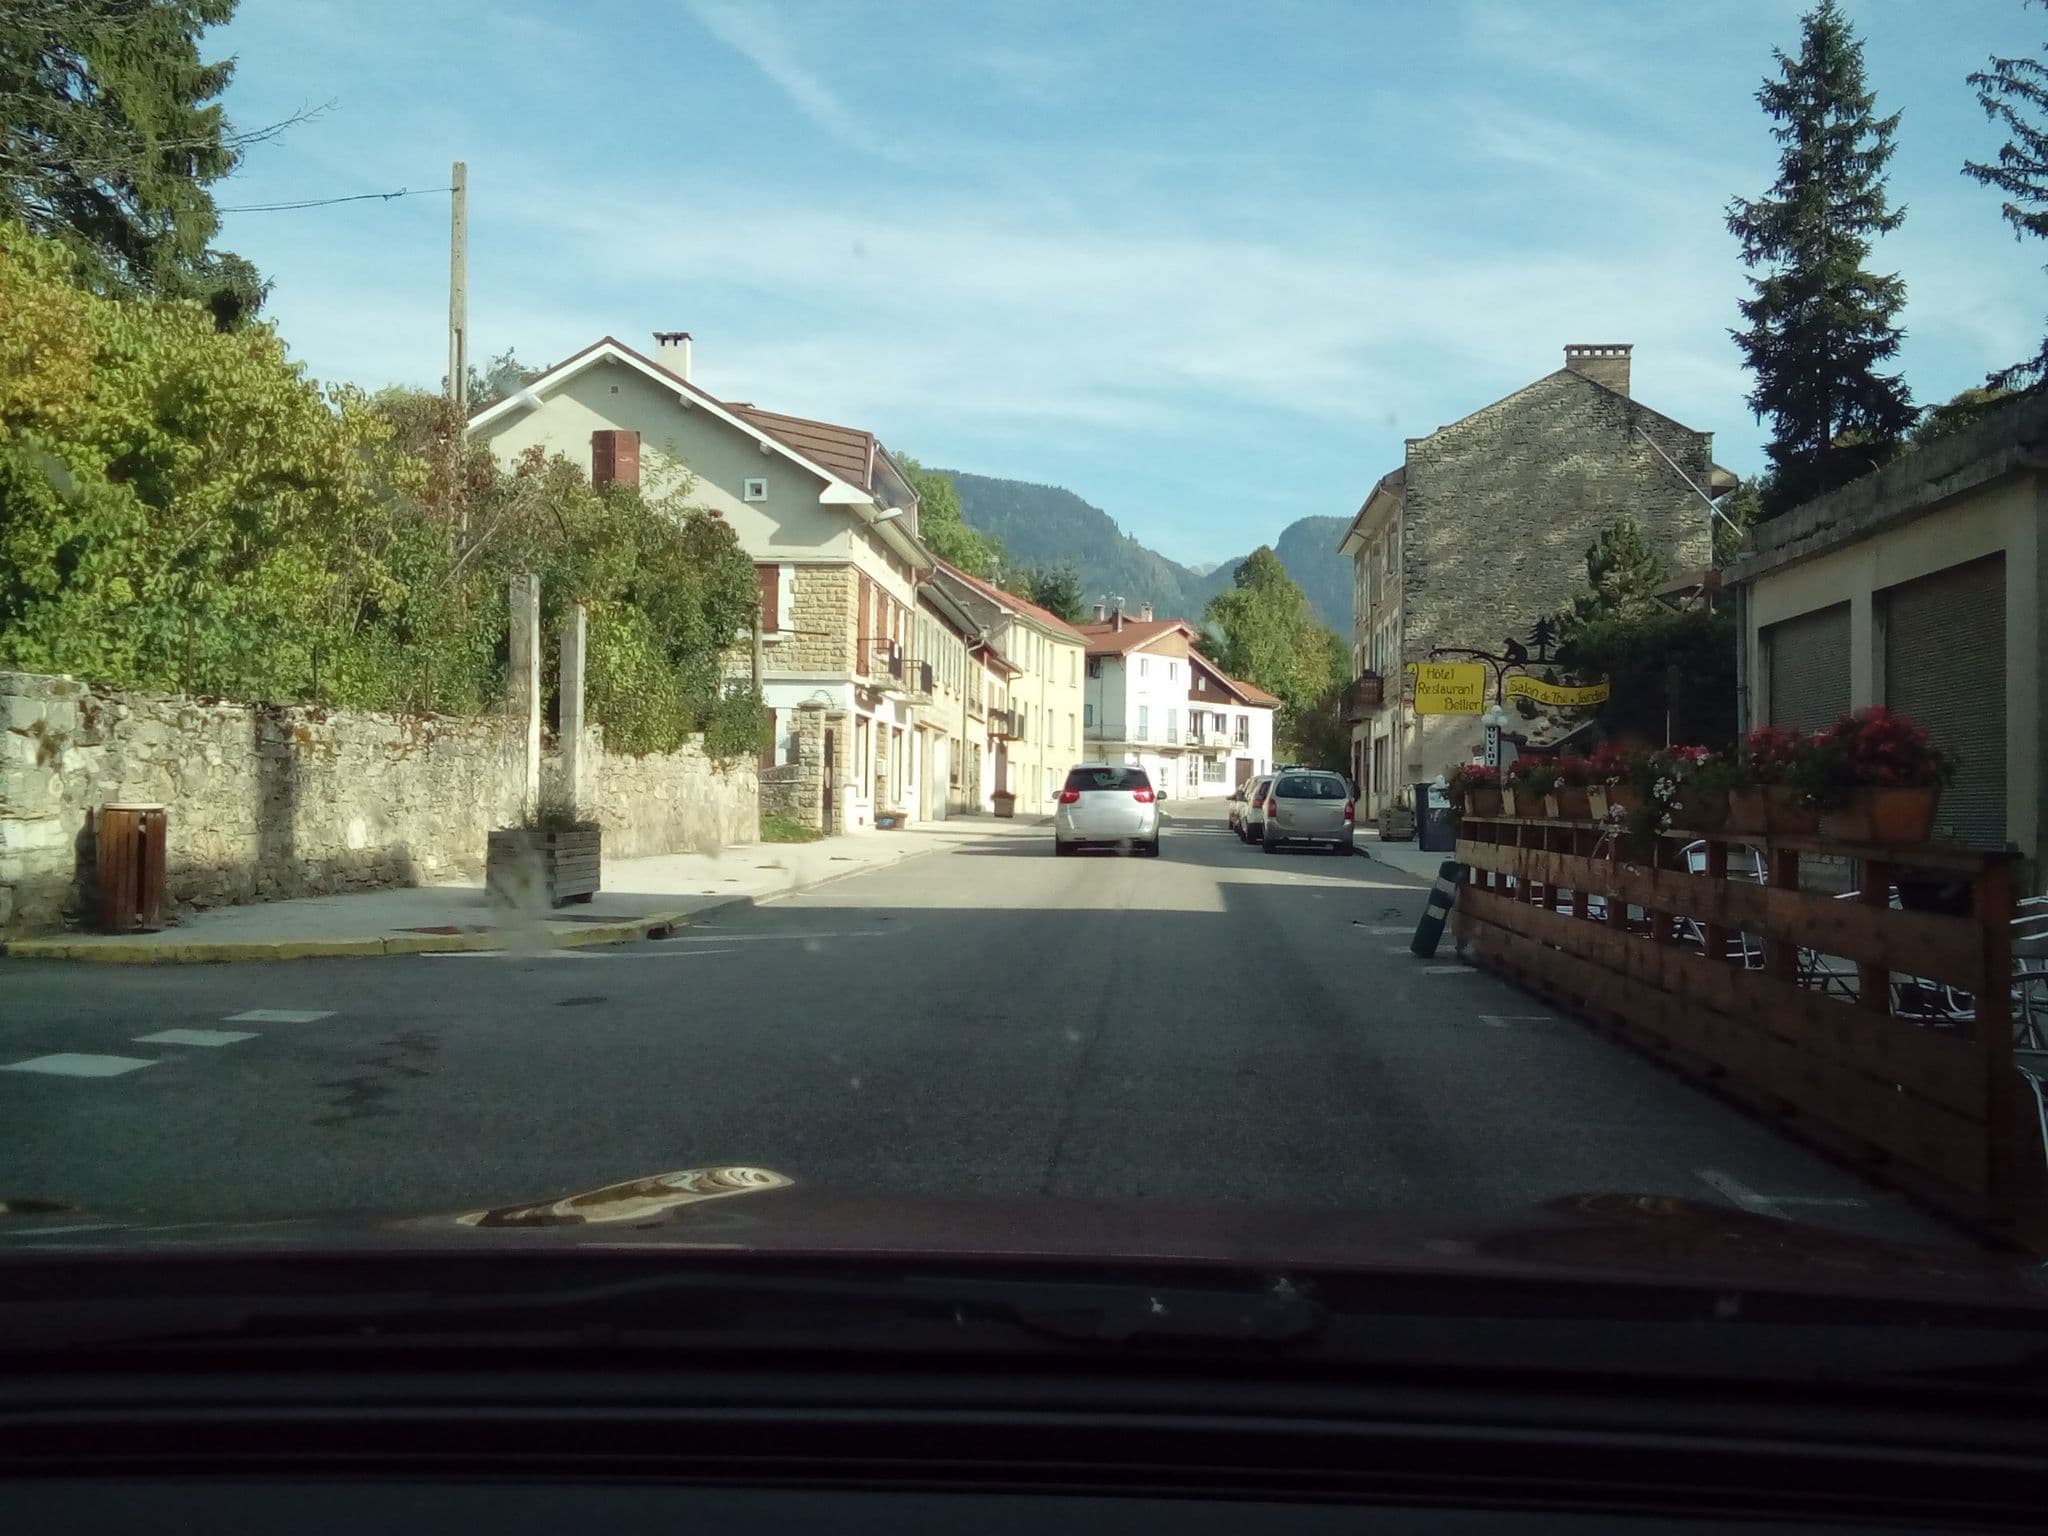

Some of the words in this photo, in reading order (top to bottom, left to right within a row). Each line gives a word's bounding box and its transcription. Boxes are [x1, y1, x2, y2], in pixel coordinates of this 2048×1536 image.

[1426, 667, 1455, 680] Hôtel
[1418, 681, 1474, 695] Restaurant
[1510, 679, 1539, 697] Salon
